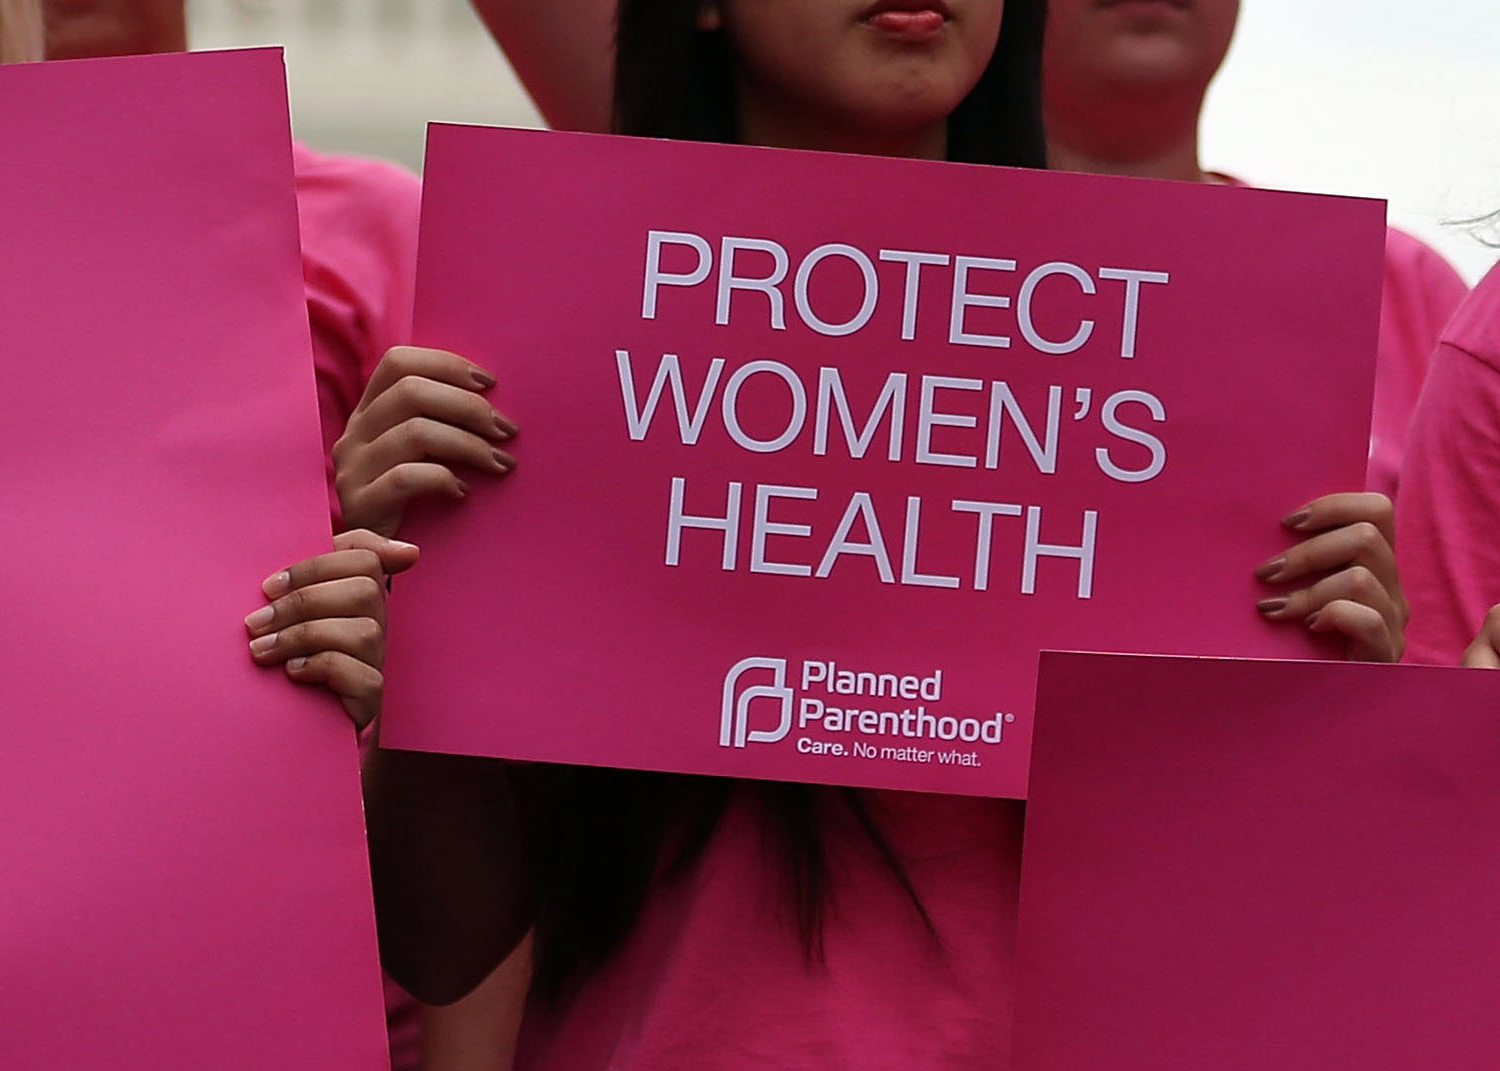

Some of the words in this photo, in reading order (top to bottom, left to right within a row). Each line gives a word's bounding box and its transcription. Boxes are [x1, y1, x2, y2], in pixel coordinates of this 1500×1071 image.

[641, 230, 1169, 359] PROTECT
[615, 349, 1167, 483] WOMEN'S
[664, 476, 1099, 599] HEALTH
[801, 660, 943, 701] Planned
[797, 737, 849, 756] Care.
[853, 742, 877, 759] No
[881, 747, 935, 764] matter
[938, 750, 982, 767] what.
